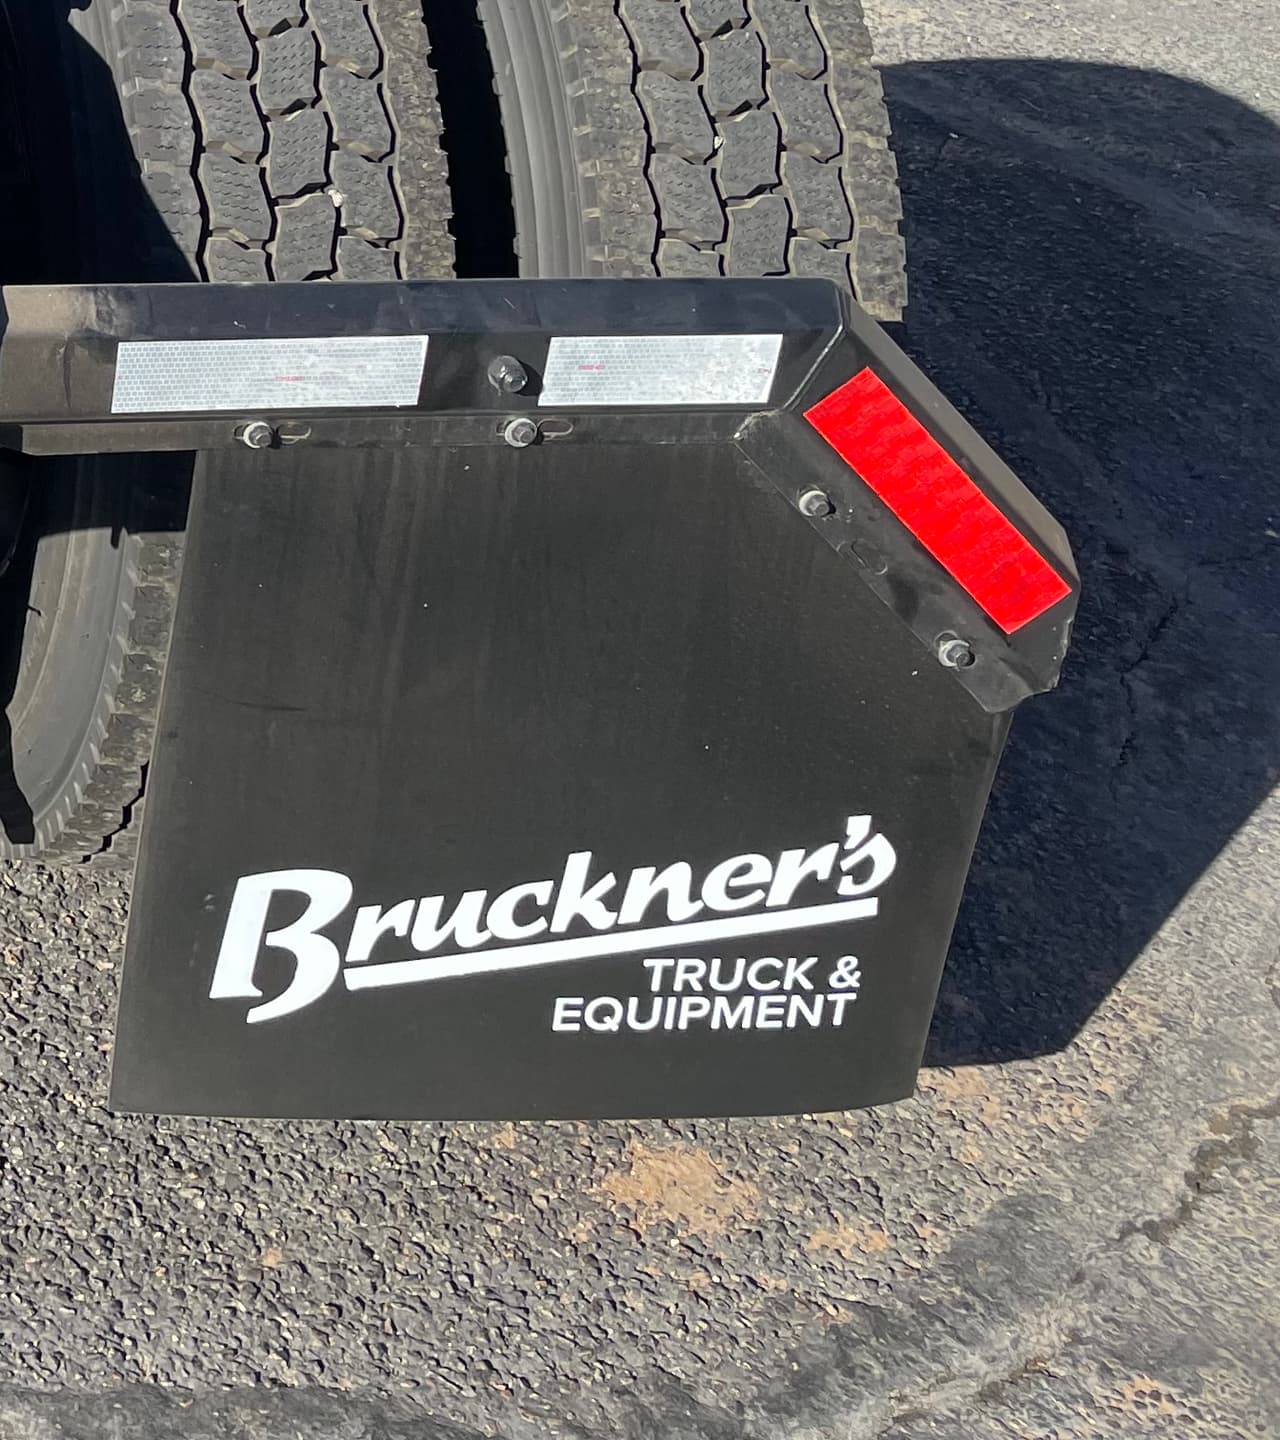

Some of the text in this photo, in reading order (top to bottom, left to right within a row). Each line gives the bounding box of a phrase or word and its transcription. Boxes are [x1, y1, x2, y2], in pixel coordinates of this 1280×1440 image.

[210, 815, 897, 1024] Bruckner's
[644, 956, 862, 992] TRUCK &
[552, 992, 857, 1032] EQUIPMENT
